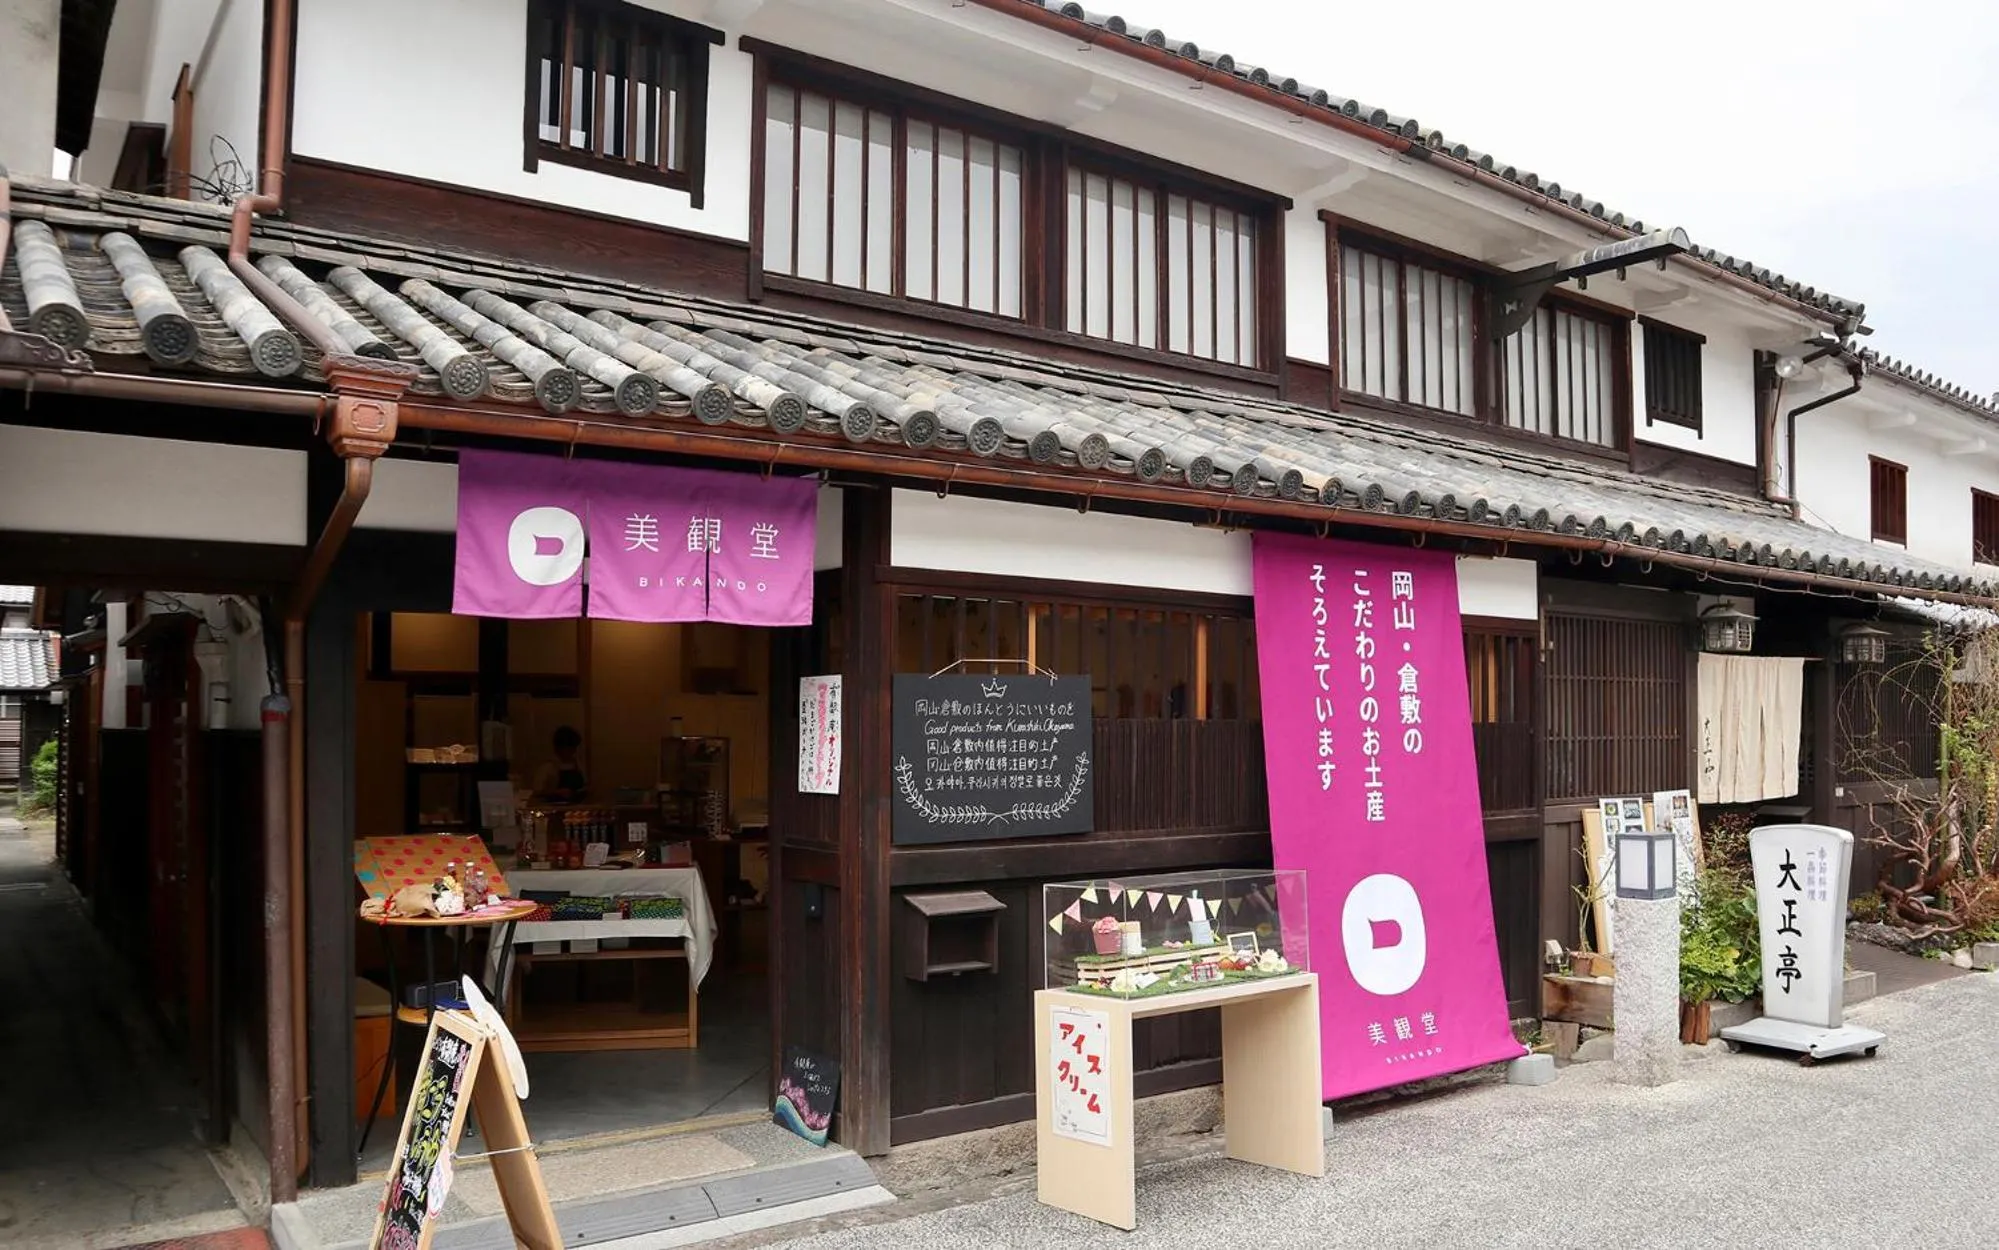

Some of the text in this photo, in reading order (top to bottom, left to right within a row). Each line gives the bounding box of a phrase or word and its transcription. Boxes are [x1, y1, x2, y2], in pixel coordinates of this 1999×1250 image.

[624, 512, 780, 560] 美観堂
[639, 576, 767, 592] BIKANDO
[1309, 564, 1337, 790] そろえています
[1353, 569, 1386, 821] こだわりのお土産
[1391, 571, 1423, 754] 岡山・倉敷の
[924, 719, 950, 736] Good
[949, 721, 983, 736] products
[985, 718, 1003, 733] from
[1776, 848, 1802, 995] 大正亭
[1367, 1011, 1439, 1047] 美観堂
